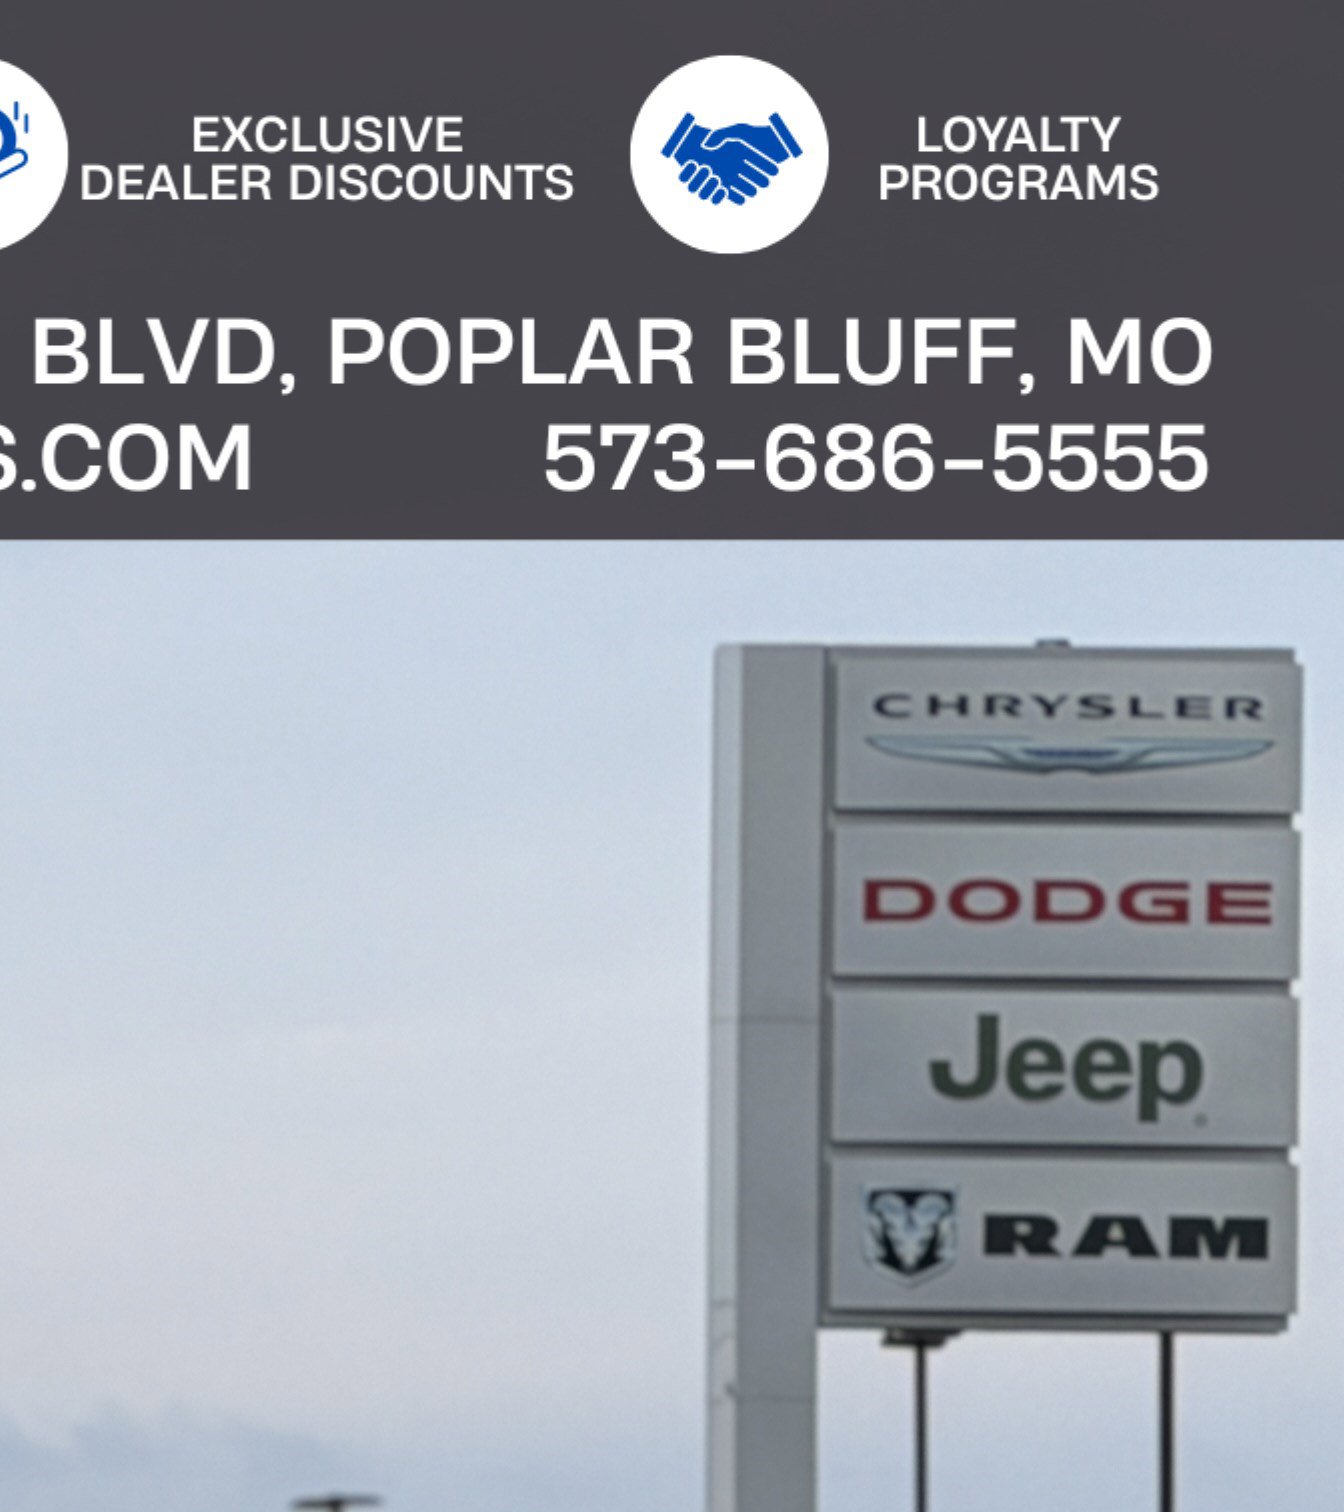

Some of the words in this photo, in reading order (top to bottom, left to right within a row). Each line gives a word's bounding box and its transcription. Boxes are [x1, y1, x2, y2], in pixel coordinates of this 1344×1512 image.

[873, 692, 1265, 722] CHRYSLER
[863, 879, 1274, 926] DODGE
[929, 1013, 1203, 1123] Jeep
[983, 1213, 1270, 1261] RAM
